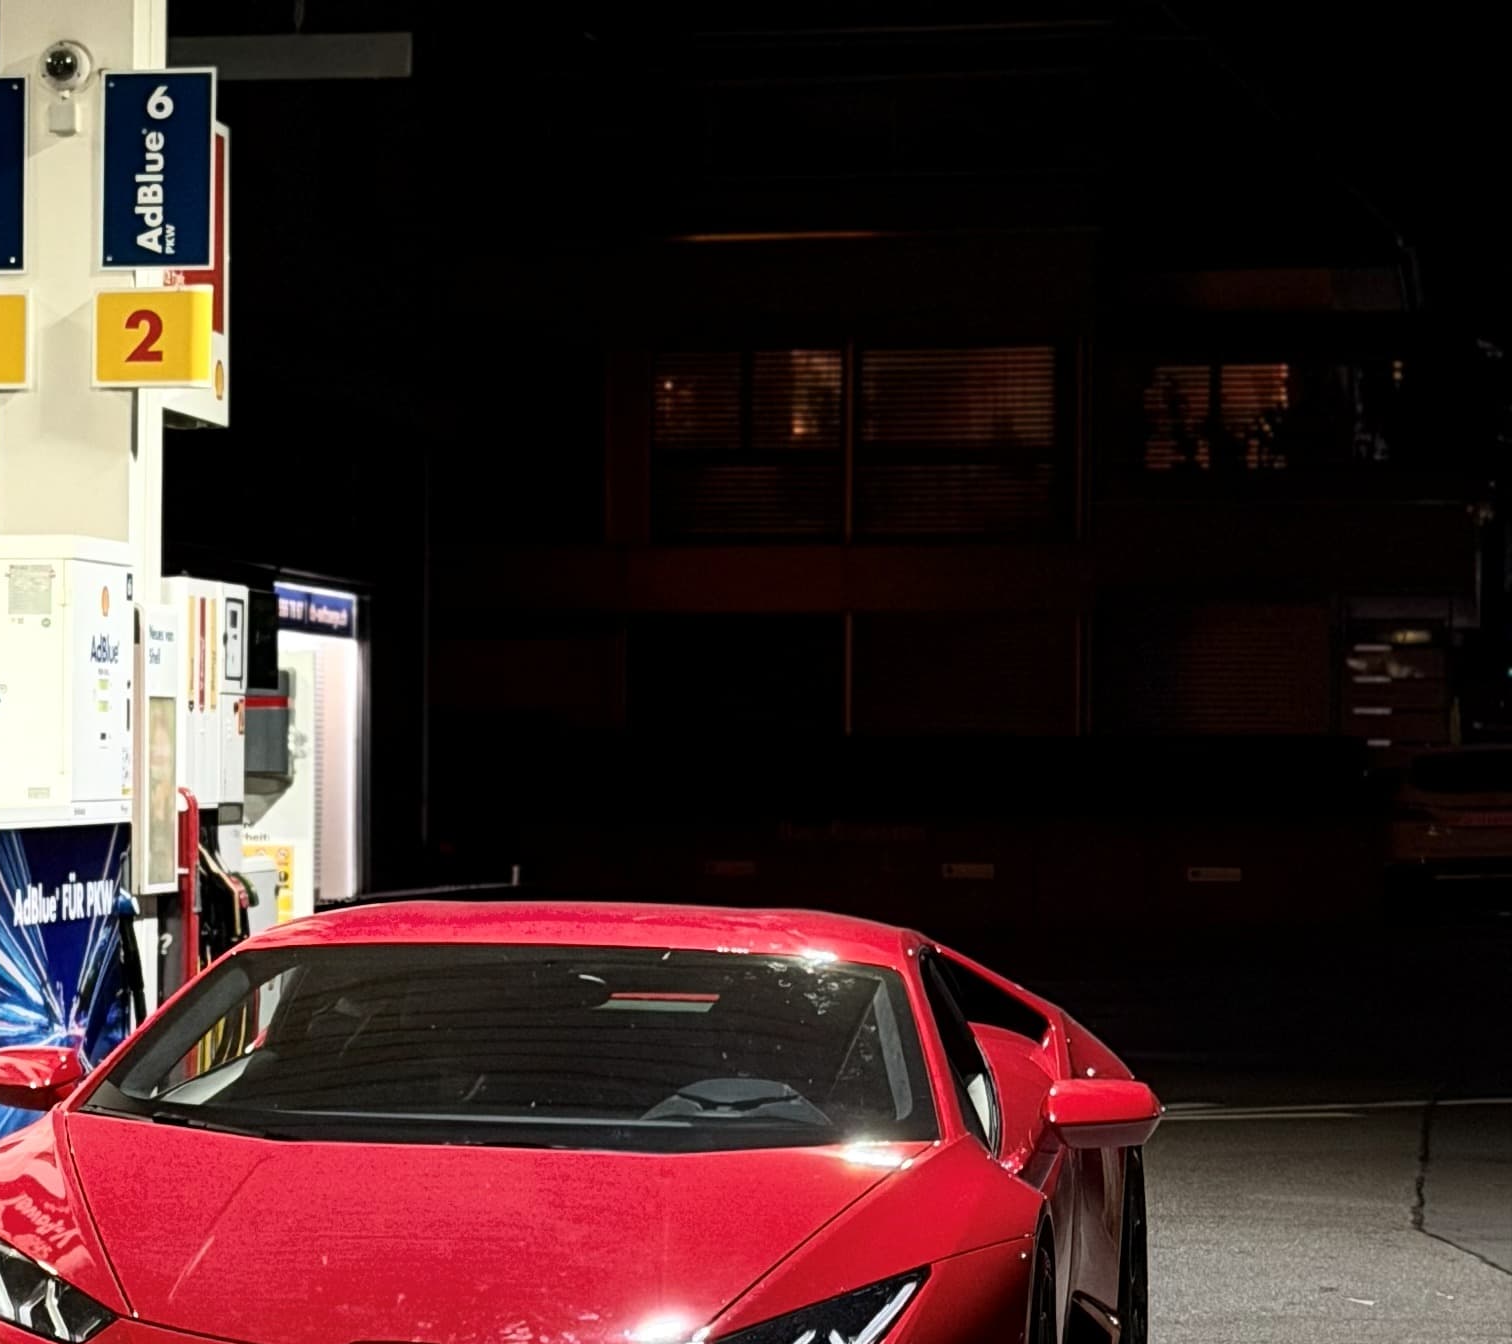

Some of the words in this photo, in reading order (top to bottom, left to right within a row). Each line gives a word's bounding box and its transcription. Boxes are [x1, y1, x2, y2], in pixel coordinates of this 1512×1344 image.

[146, 85, 174, 120] 6
[135, 133, 165, 254] AdBlue
[165, 224, 176, 255] PKW
[124, 309, 164, 363] 2
[61, 872, 84, 920] FÜR
[86, 879, 114, 917] PKW
